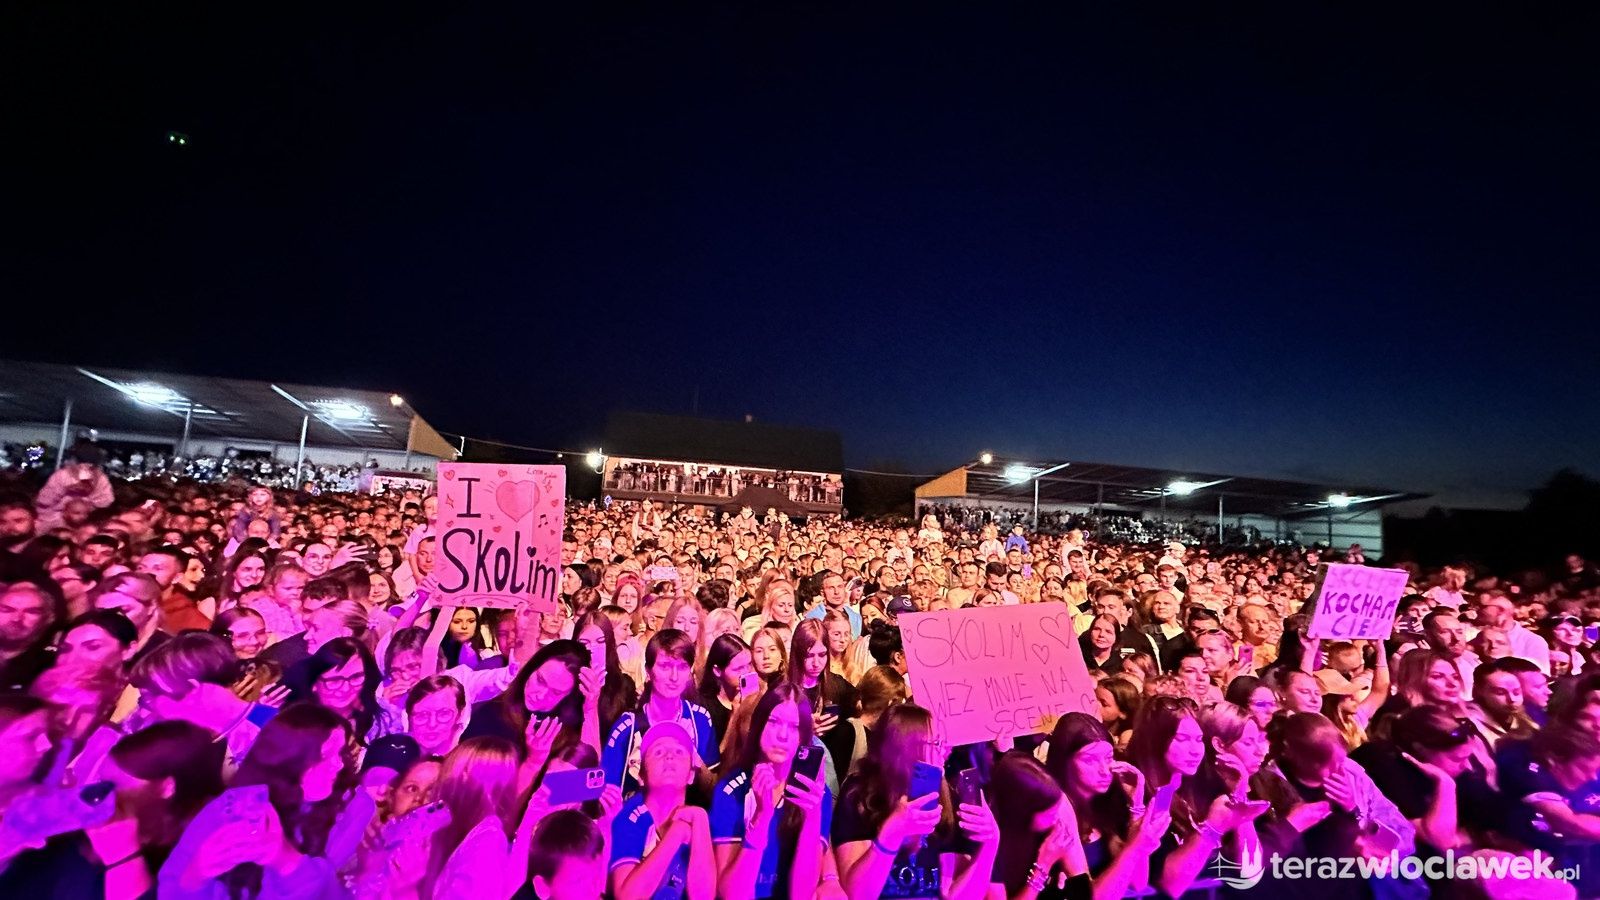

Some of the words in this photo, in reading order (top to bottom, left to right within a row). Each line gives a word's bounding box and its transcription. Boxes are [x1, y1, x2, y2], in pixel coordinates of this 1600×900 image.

[456, 477, 482, 519] I
[914, 616, 1028, 668] SKOLIM
[983, 672, 1034, 711] MNIE
[1040, 666, 1075, 697] NA
